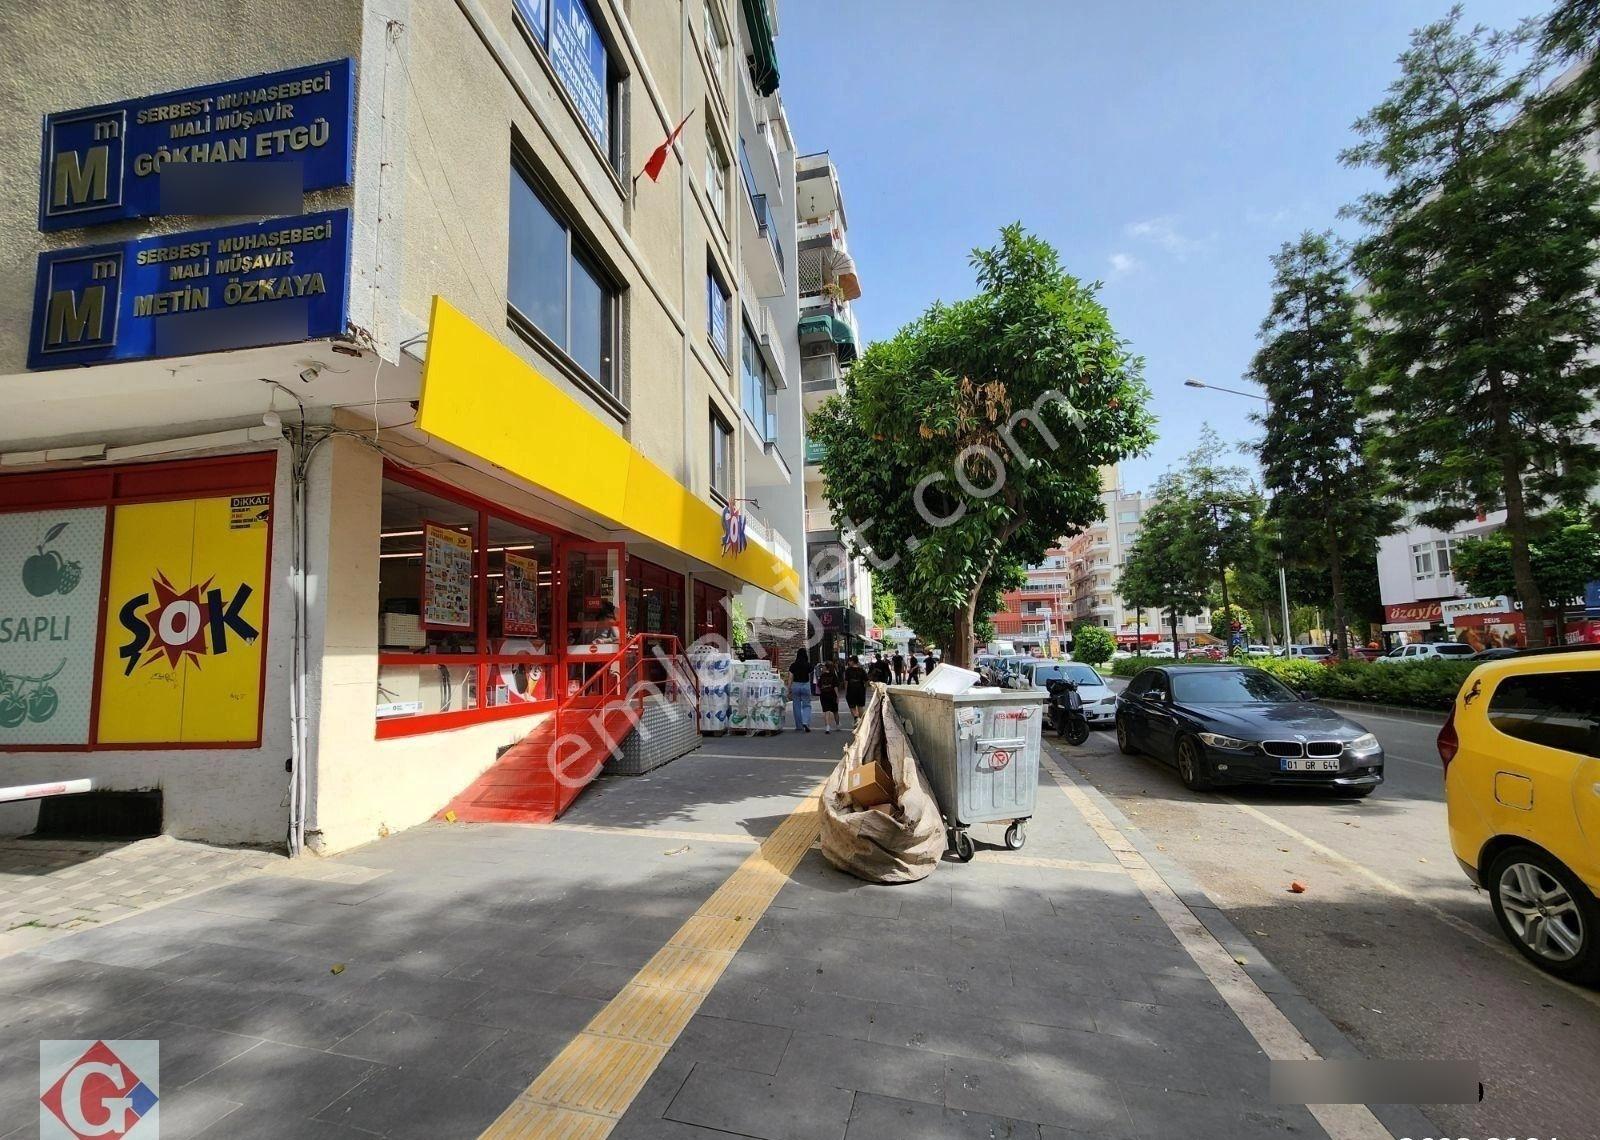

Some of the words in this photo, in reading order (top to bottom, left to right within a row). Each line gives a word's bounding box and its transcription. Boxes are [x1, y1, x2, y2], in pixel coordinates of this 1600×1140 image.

[136, 98, 213, 125] SERBEST
[216, 70, 332, 111] MUHASEBECİ
[170, 115, 211, 139] MALİ
[215, 101, 294, 132] MÜŞAVİR
[133, 137, 247, 177] GÖKHAN
[256, 117, 330, 157] ETGÜ
[54, 145, 109, 207] M
[136, 242, 212, 266] SERBEST
[217, 219, 332, 255] MUHASEBECİ
[170, 258, 209, 281] MALİ
[216, 248, 294, 275] MÜŞAVİR
[49, 286, 106, 345] M
[133, 283, 209, 318] METİN
[224, 273, 326, 306] ÖZKAYA
[118, 582, 260, 677] ŞOK
[1287, 761, 1297, 769] 01
[1305, 761, 1316, 770] GR
[1322, 761, 1338, 770] 644
